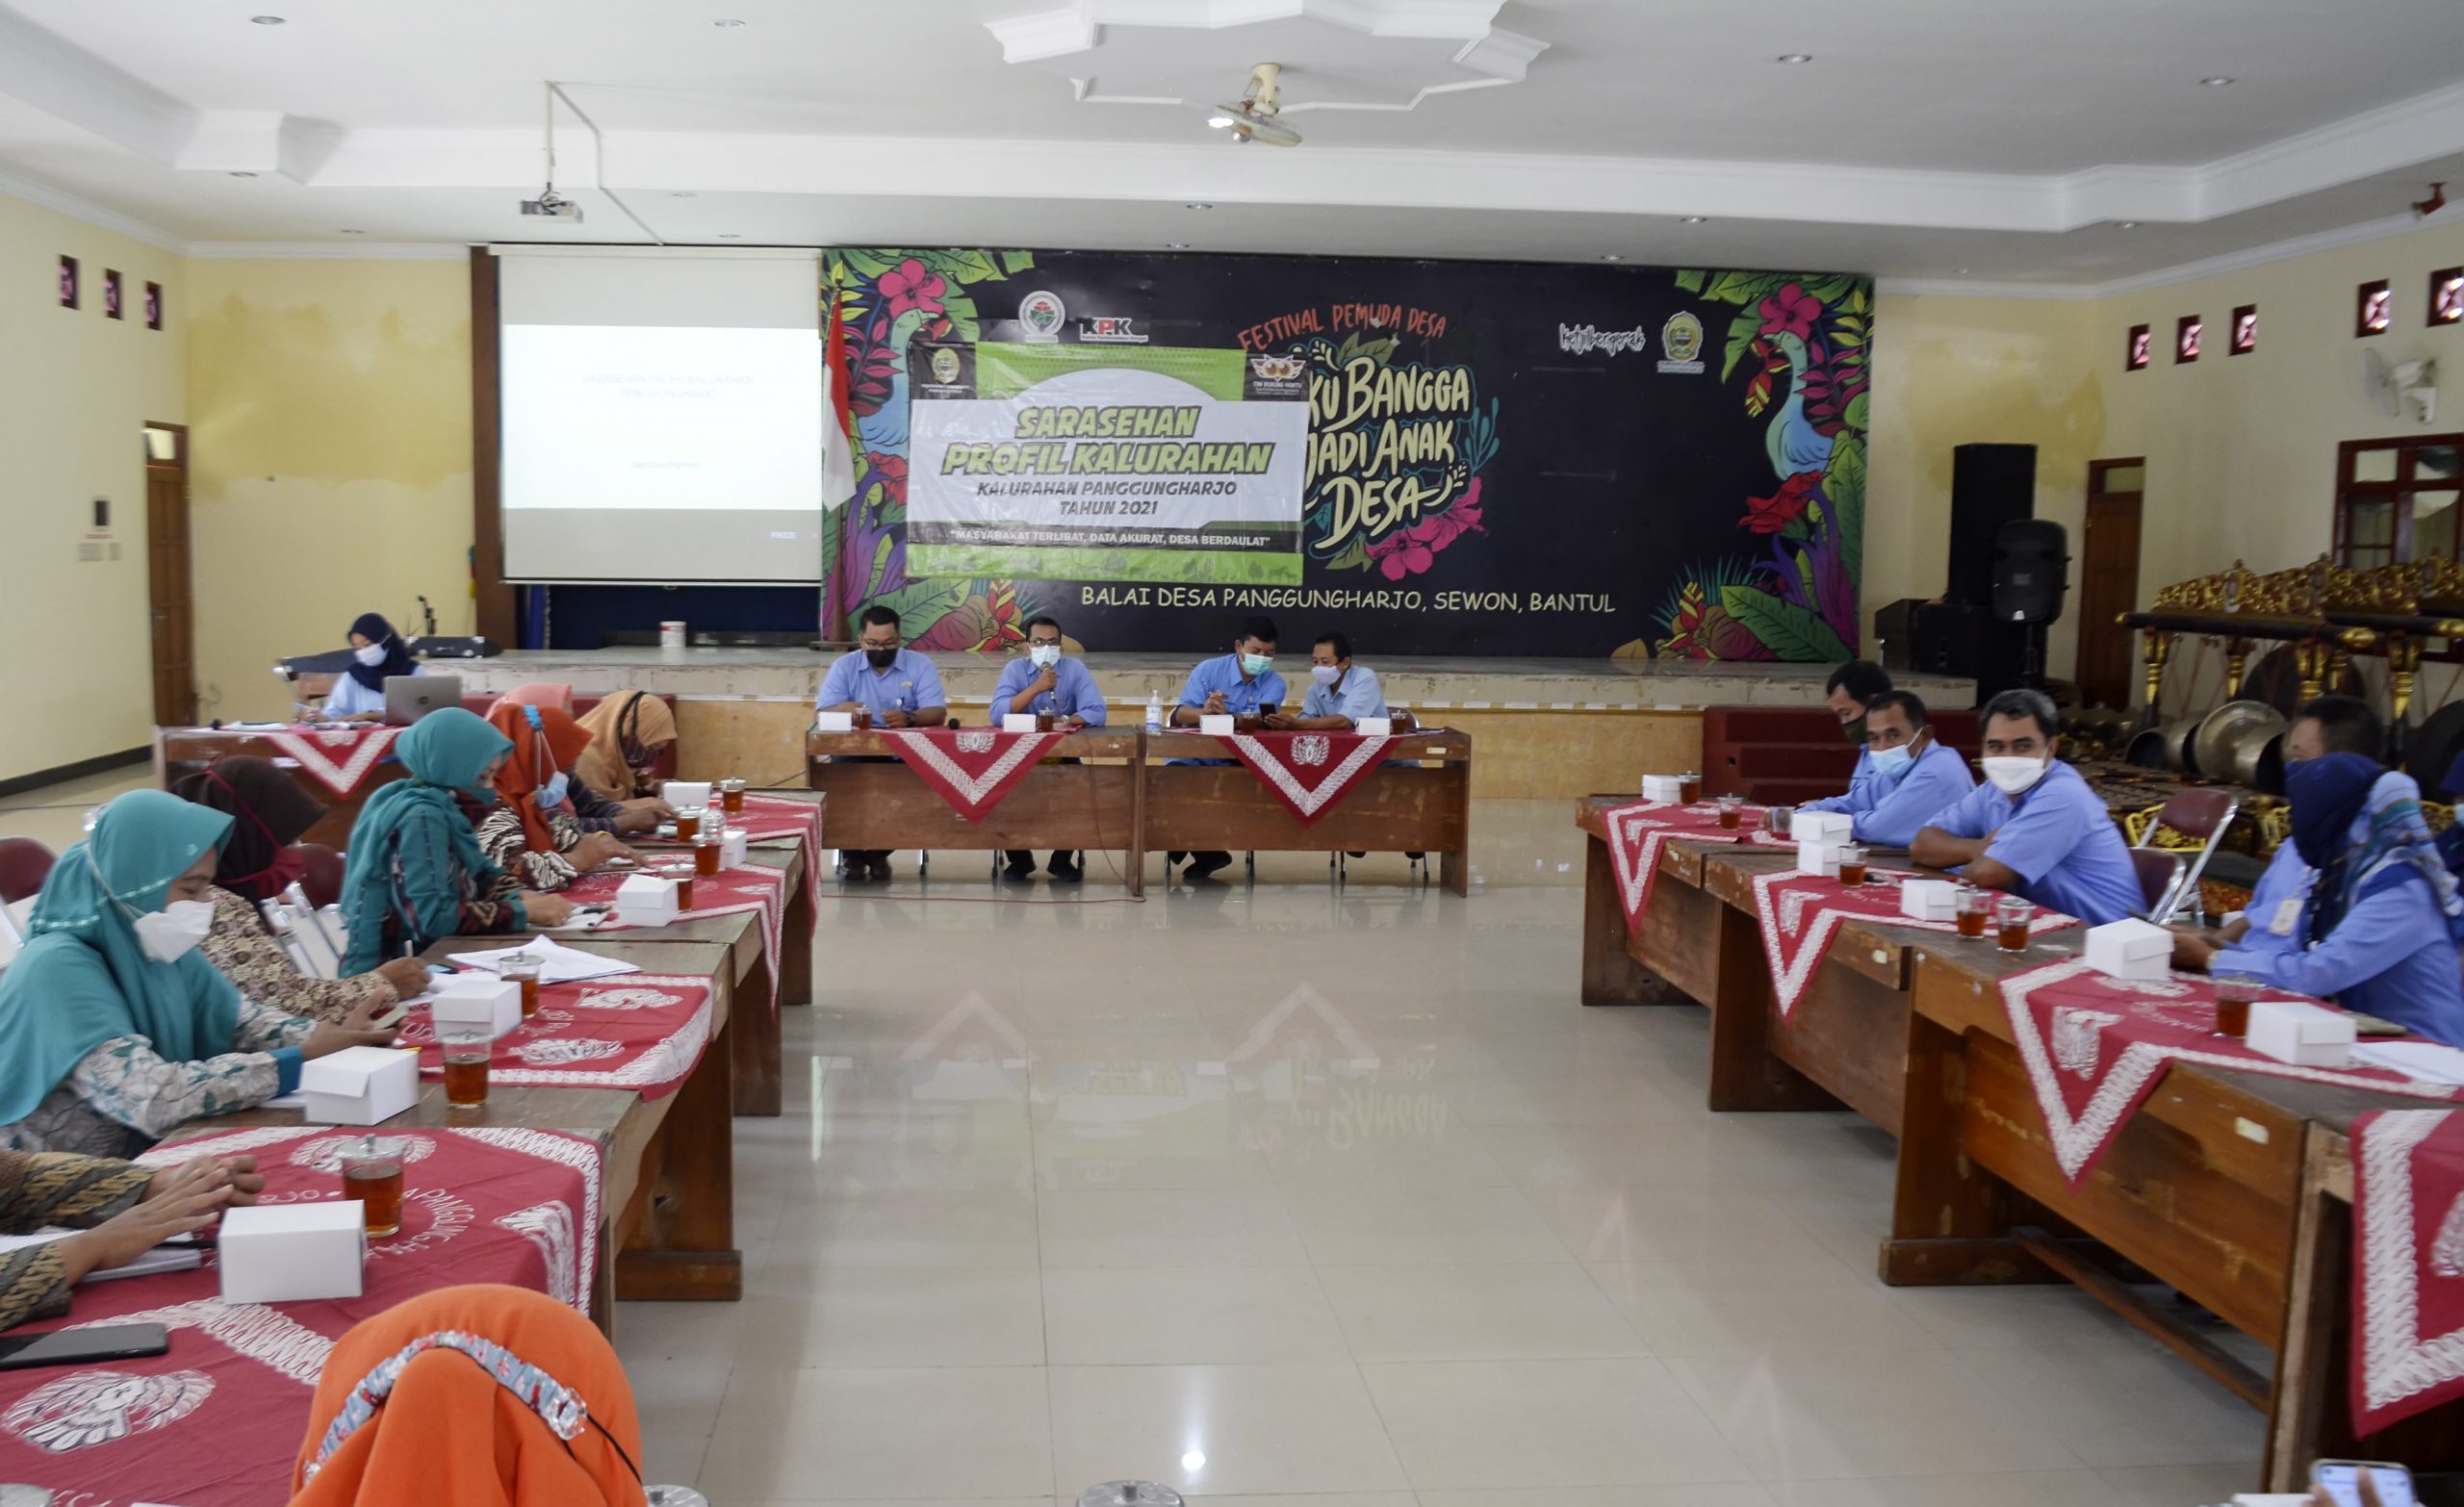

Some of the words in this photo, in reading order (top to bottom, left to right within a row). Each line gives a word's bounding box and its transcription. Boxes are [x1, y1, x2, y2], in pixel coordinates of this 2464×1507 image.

[1238, 308, 1324, 350] FESTIVAL
[1332, 303, 1401, 331] PEMUDA
[1406, 308, 1447, 338] DESA
[1322, 356, 1470, 432] BANGGA
[1014, 405, 1202, 439] SARASEHAN
[940, 442, 1069, 475] PROFIL
[1069, 442, 1276, 475] KALURAHAN
[1305, 432, 1367, 491] JADI
[1362, 419, 1455, 477] ANAK
[977, 482, 1078, 497] KALURAHAN
[1081, 481, 1238, 496] PANGGUNGHARJO
[1060, 500, 1116, 516] TAHUN
[1117, 500, 1159, 515] 2021
[1315, 475, 1441, 549] DESA
[1032, 531, 1087, 543] TERLIBAT,
[1090, 532, 1117, 543] DATA
[1117, 533, 1167, 545] AKURAT,
[1168, 534, 1199, 545] DESA
[1202, 535, 1270, 547] BERDAULAT"
[1082, 586, 1150, 606] BALAI
[1158, 587, 1217, 607] DESA
[1223, 588, 1426, 613] PANGGUNGHARJO,
[1433, 591, 1524, 614] SEWON,
[1529, 592, 1616, 613] BANTUL
